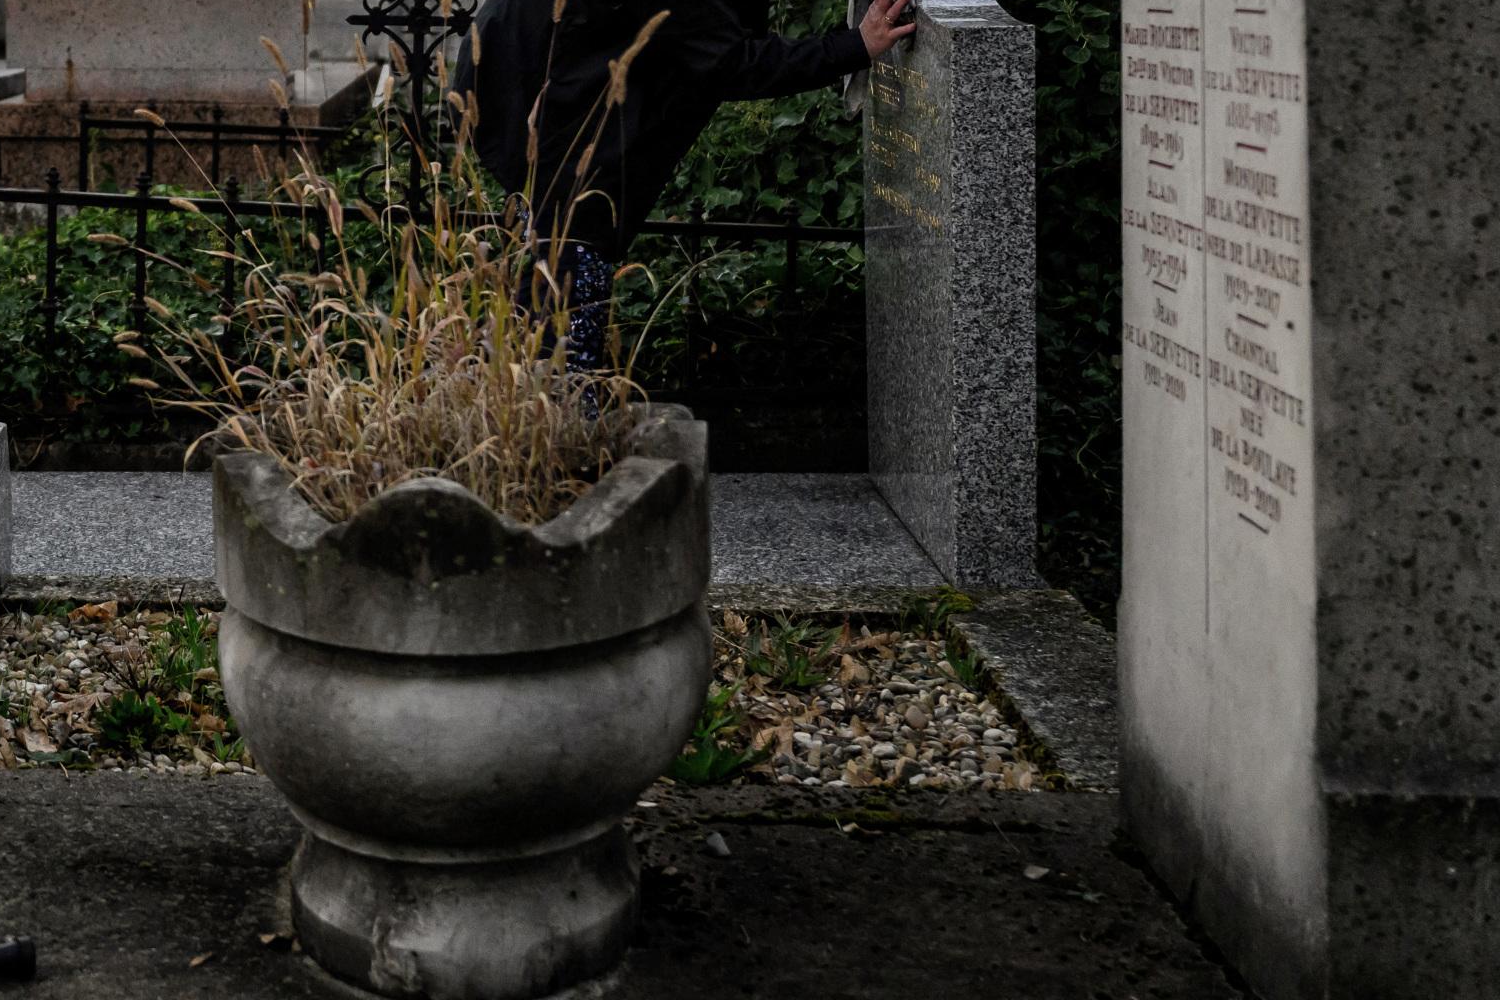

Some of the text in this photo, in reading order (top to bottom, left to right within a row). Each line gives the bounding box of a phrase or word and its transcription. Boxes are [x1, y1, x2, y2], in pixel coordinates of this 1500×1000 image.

[1124, 22, 1199, 50] MARIE ROCHETTE
[1228, 26, 1272, 56] VICTOR
[1159, 61, 1195, 86] VICTOR
[1205, 67, 1300, 101] DE LA SERVETTE
[1125, 93, 1199, 125] DE LA SERVETTE
[1223, 157, 1278, 199] MONIQUE
[1124, 207, 1202, 251] DE LA SERVETTE
[1206, 194, 1300, 244] DE LA SERVETTE
[1229, 241, 1243, 265] DE
[1154, 296, 1177, 328] JEAN
[1124, 321, 1200, 378] DE LA SERVETTE
[1224, 325, 1279, 374] CHANTAL
[1208, 357, 1305, 426] DE LA SERVETTE
[1211, 425, 1223, 452] DE
[1225, 433, 1239, 461] LA
